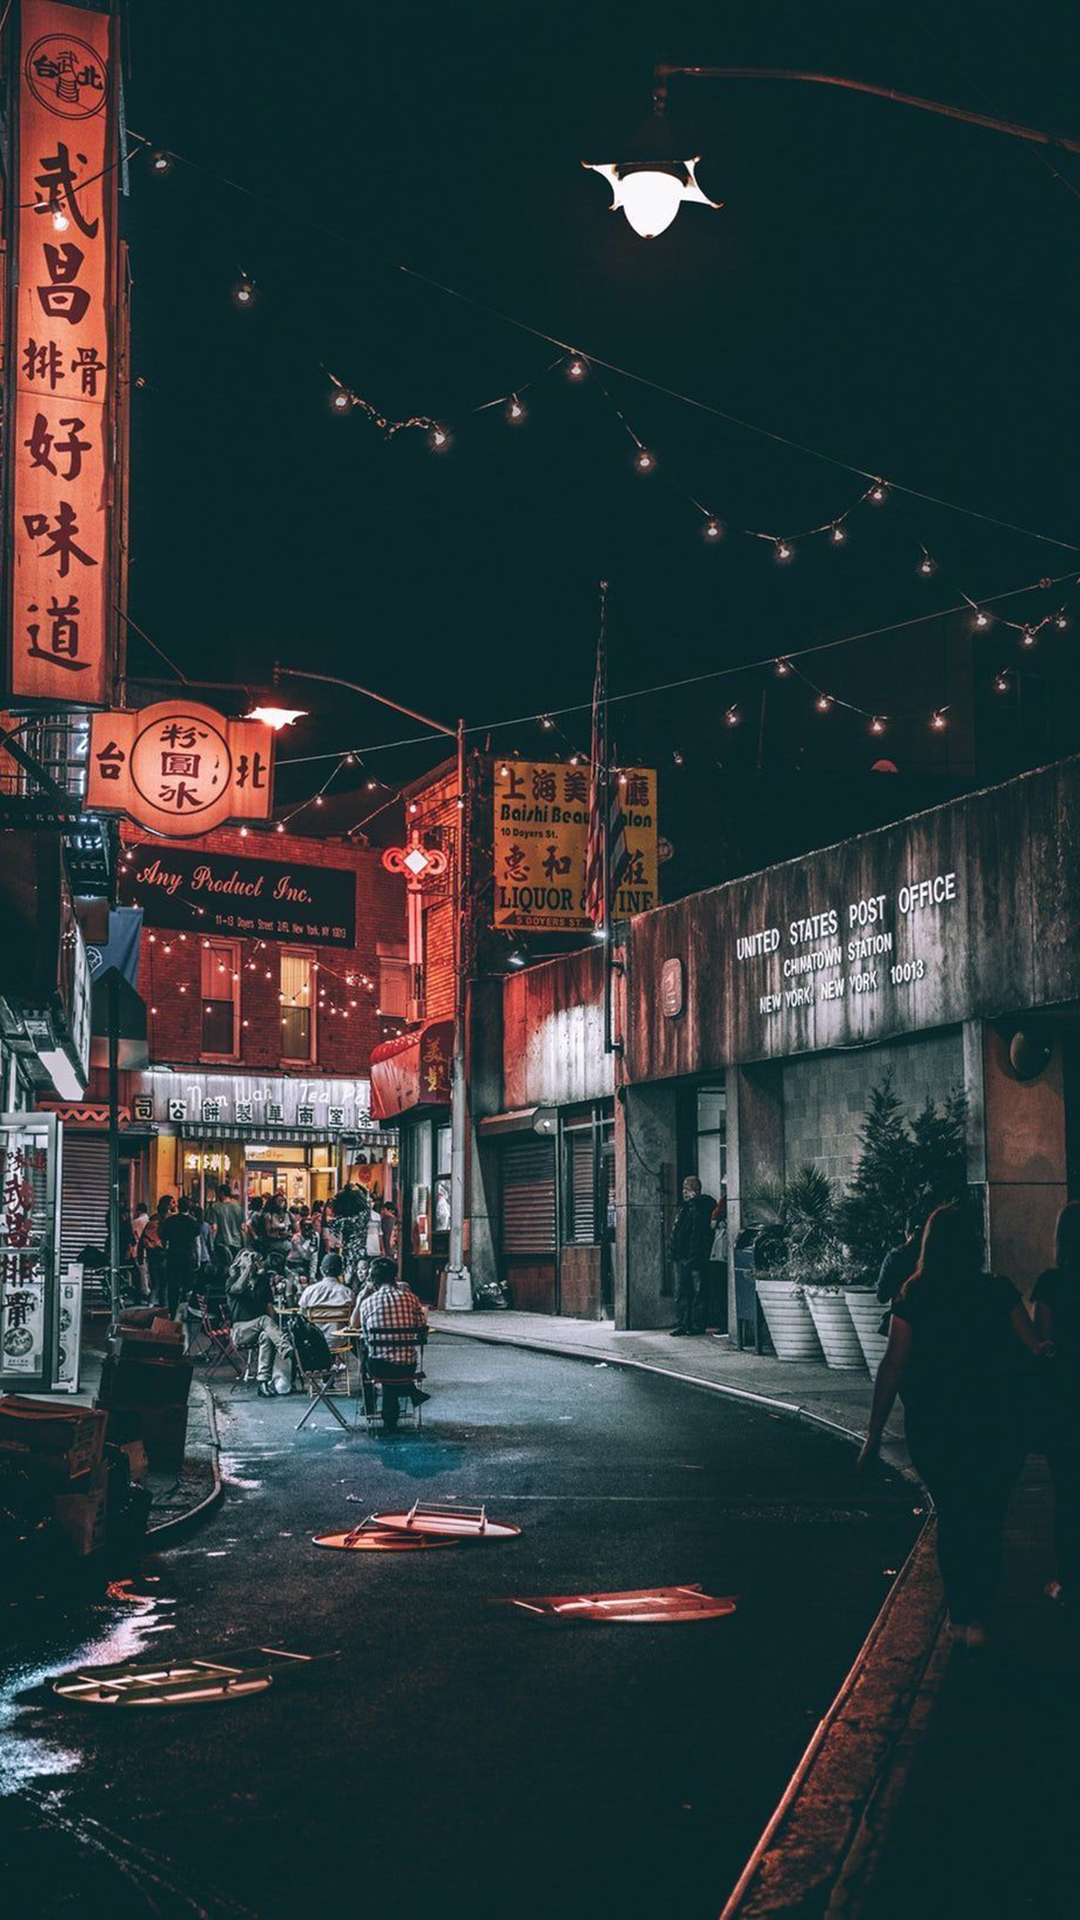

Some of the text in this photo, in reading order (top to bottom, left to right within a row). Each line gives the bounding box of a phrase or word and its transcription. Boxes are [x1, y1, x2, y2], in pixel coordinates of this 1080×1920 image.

[502, 768, 649, 807] 上海美廳
[500, 804, 549, 823] Baishi
[551, 806, 590, 825] Beau
[501, 828, 559, 840] 10 Doyers St.
[136, 860, 312, 904] Any Product Inc.
[499, 886, 574, 913] LIQUOR
[216, 915, 234, 927] 11-13
[237, 916, 255, 930] Doyers
[257, 918, 274, 931] Street
[292, 922, 304, 935] New
[322, 926, 330, 937] NY
[332, 927, 347, 939] 10013
[526, 916, 565, 926] DOYERS
[569, 917, 584, 927] ST.
[736, 873, 956, 961] UNITED STATES POST OFFICE
[783, 932, 892, 977] CHINATOWN STATION
[759, 959, 924, 1015] NEW YORK, NEW YORK 10013
[235, 1077, 273, 1107] Wah
[299, 1082, 330, 1104] Tea
